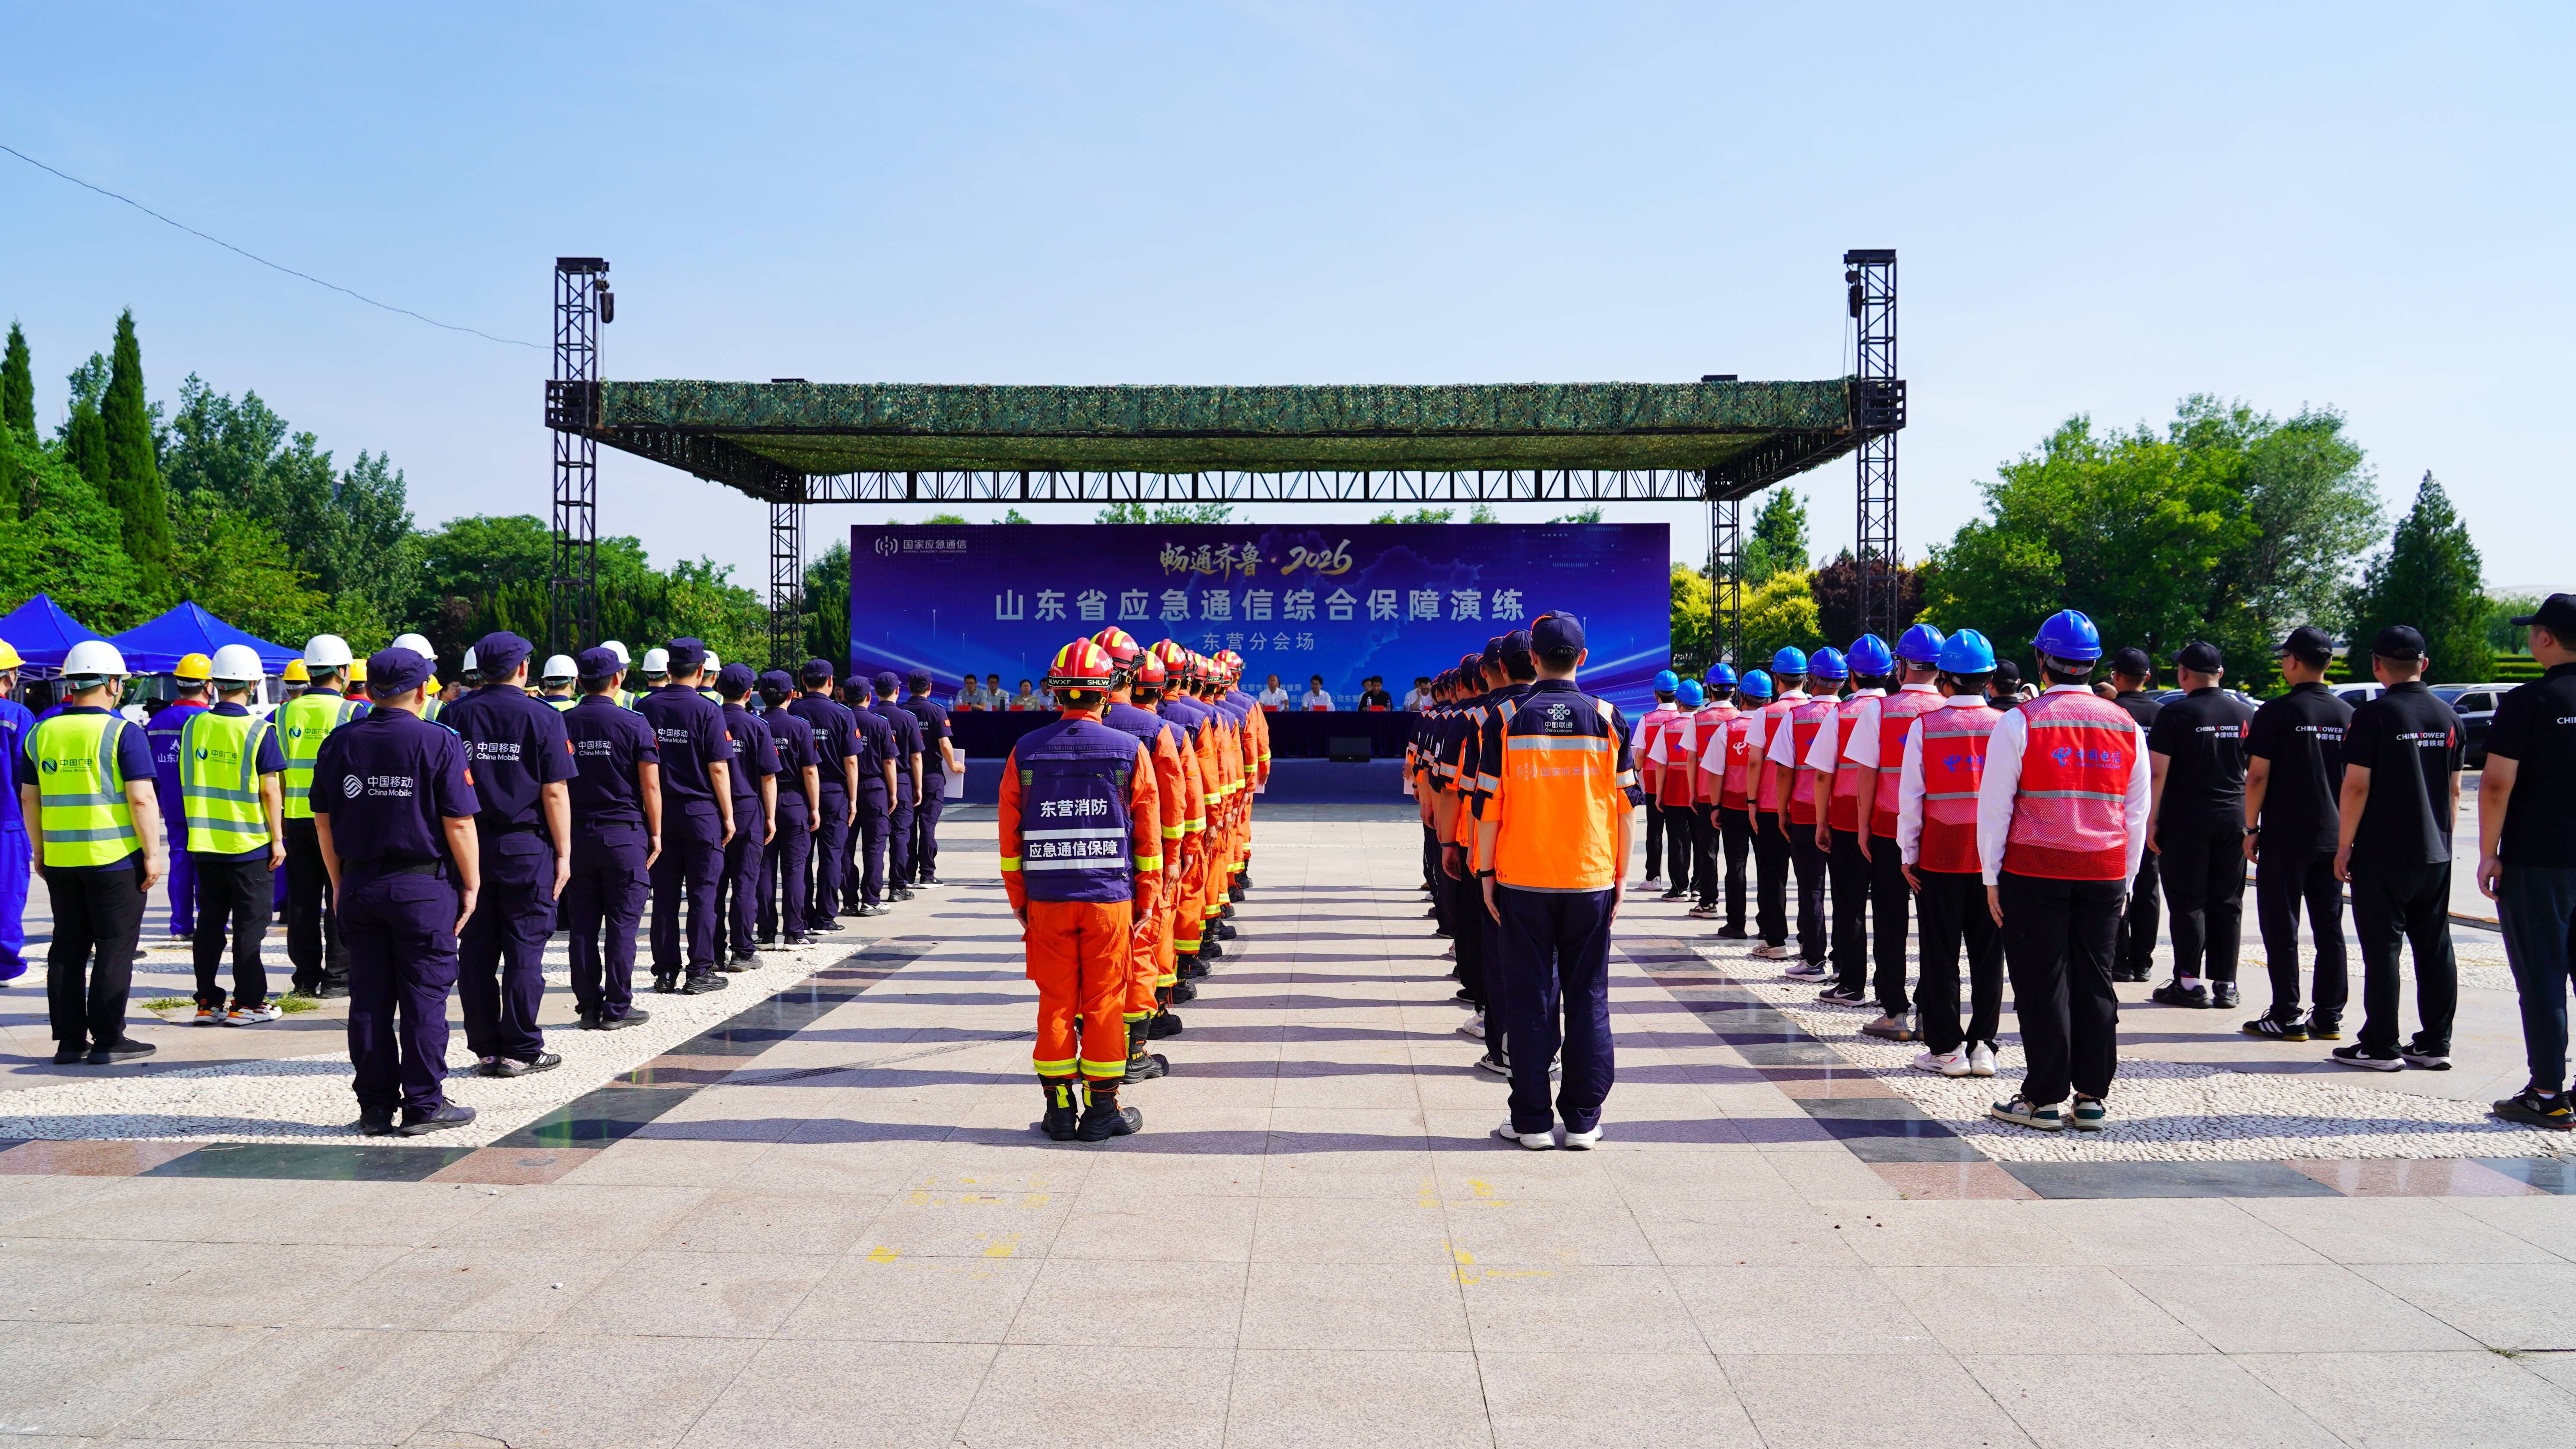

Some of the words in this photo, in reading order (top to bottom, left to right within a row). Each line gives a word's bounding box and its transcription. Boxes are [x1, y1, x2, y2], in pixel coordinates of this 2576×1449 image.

[903, 540, 967, 549] 国家应急通信
[996, 588, 1525, 621] 山东省应急通信综合保障演练
[1202, 632, 1314, 651] 东营分会场
[658, 728, 688, 738] 中国移动
[477, 742, 520, 753] 中国移动
[578, 740, 611, 749] 中国移动
[2076, 748, 2121, 763] 中国电信
[368, 775, 413, 788] 中国移动
[388, 789, 412, 797] Mobile
[1040, 798, 1108, 818] 东营消防
[1029, 840, 1118, 858] 应急通信保障
